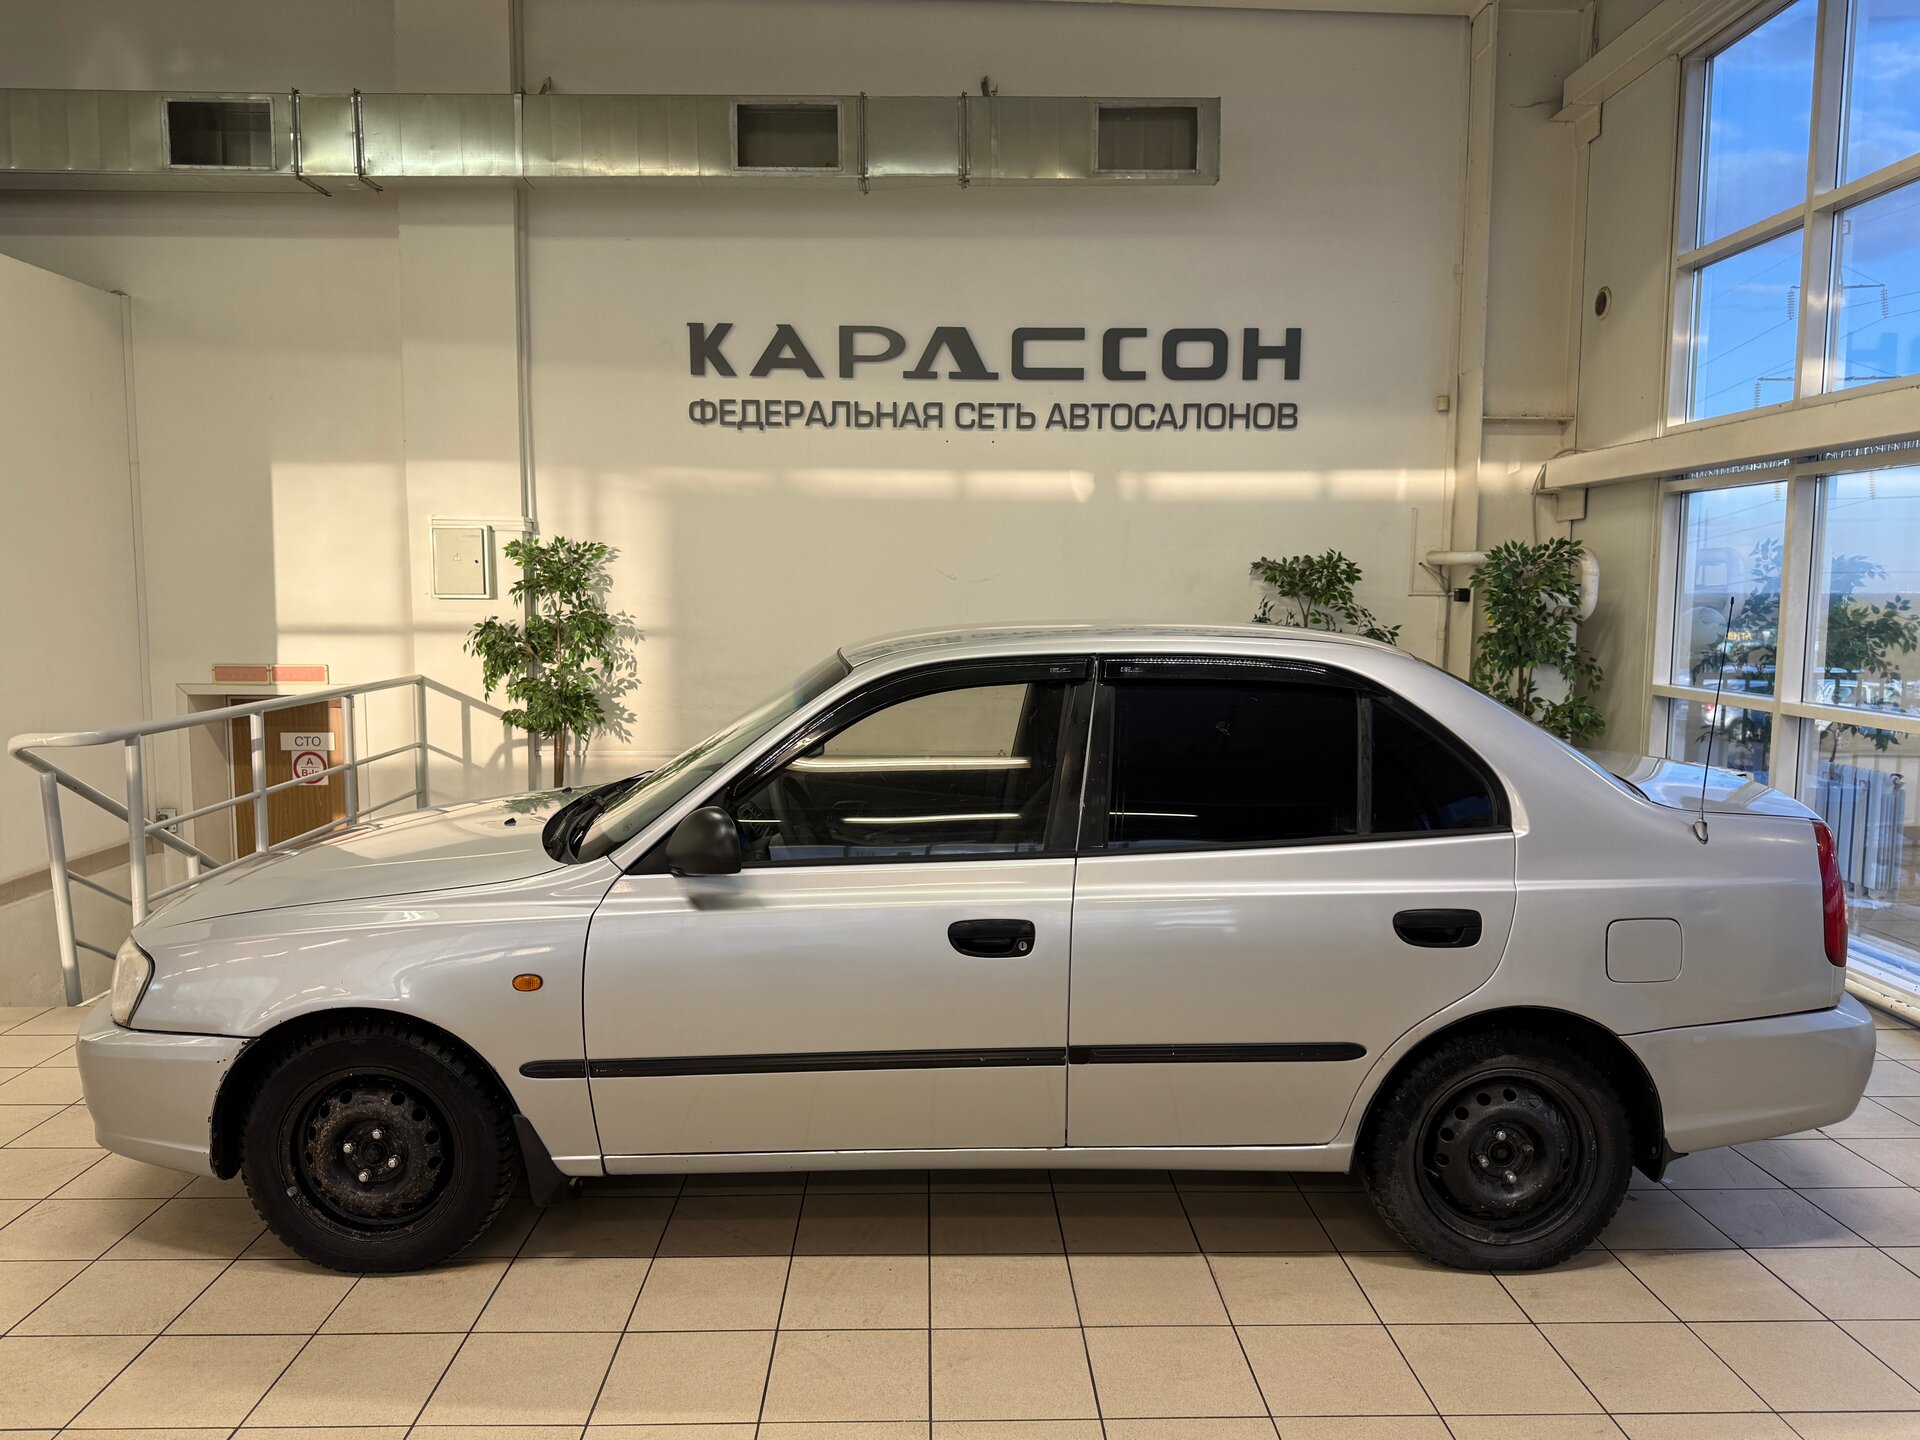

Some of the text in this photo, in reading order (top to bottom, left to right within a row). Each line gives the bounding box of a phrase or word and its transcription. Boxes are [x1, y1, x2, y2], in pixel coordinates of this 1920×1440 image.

[686, 322, 1302, 380] КАРАССОН
[688, 398, 1298, 431] ФЕДЕРАЛЬНАЯ СЕТЬ АВТОСАЛОНОВ
[294, 735, 322, 747] СТО
